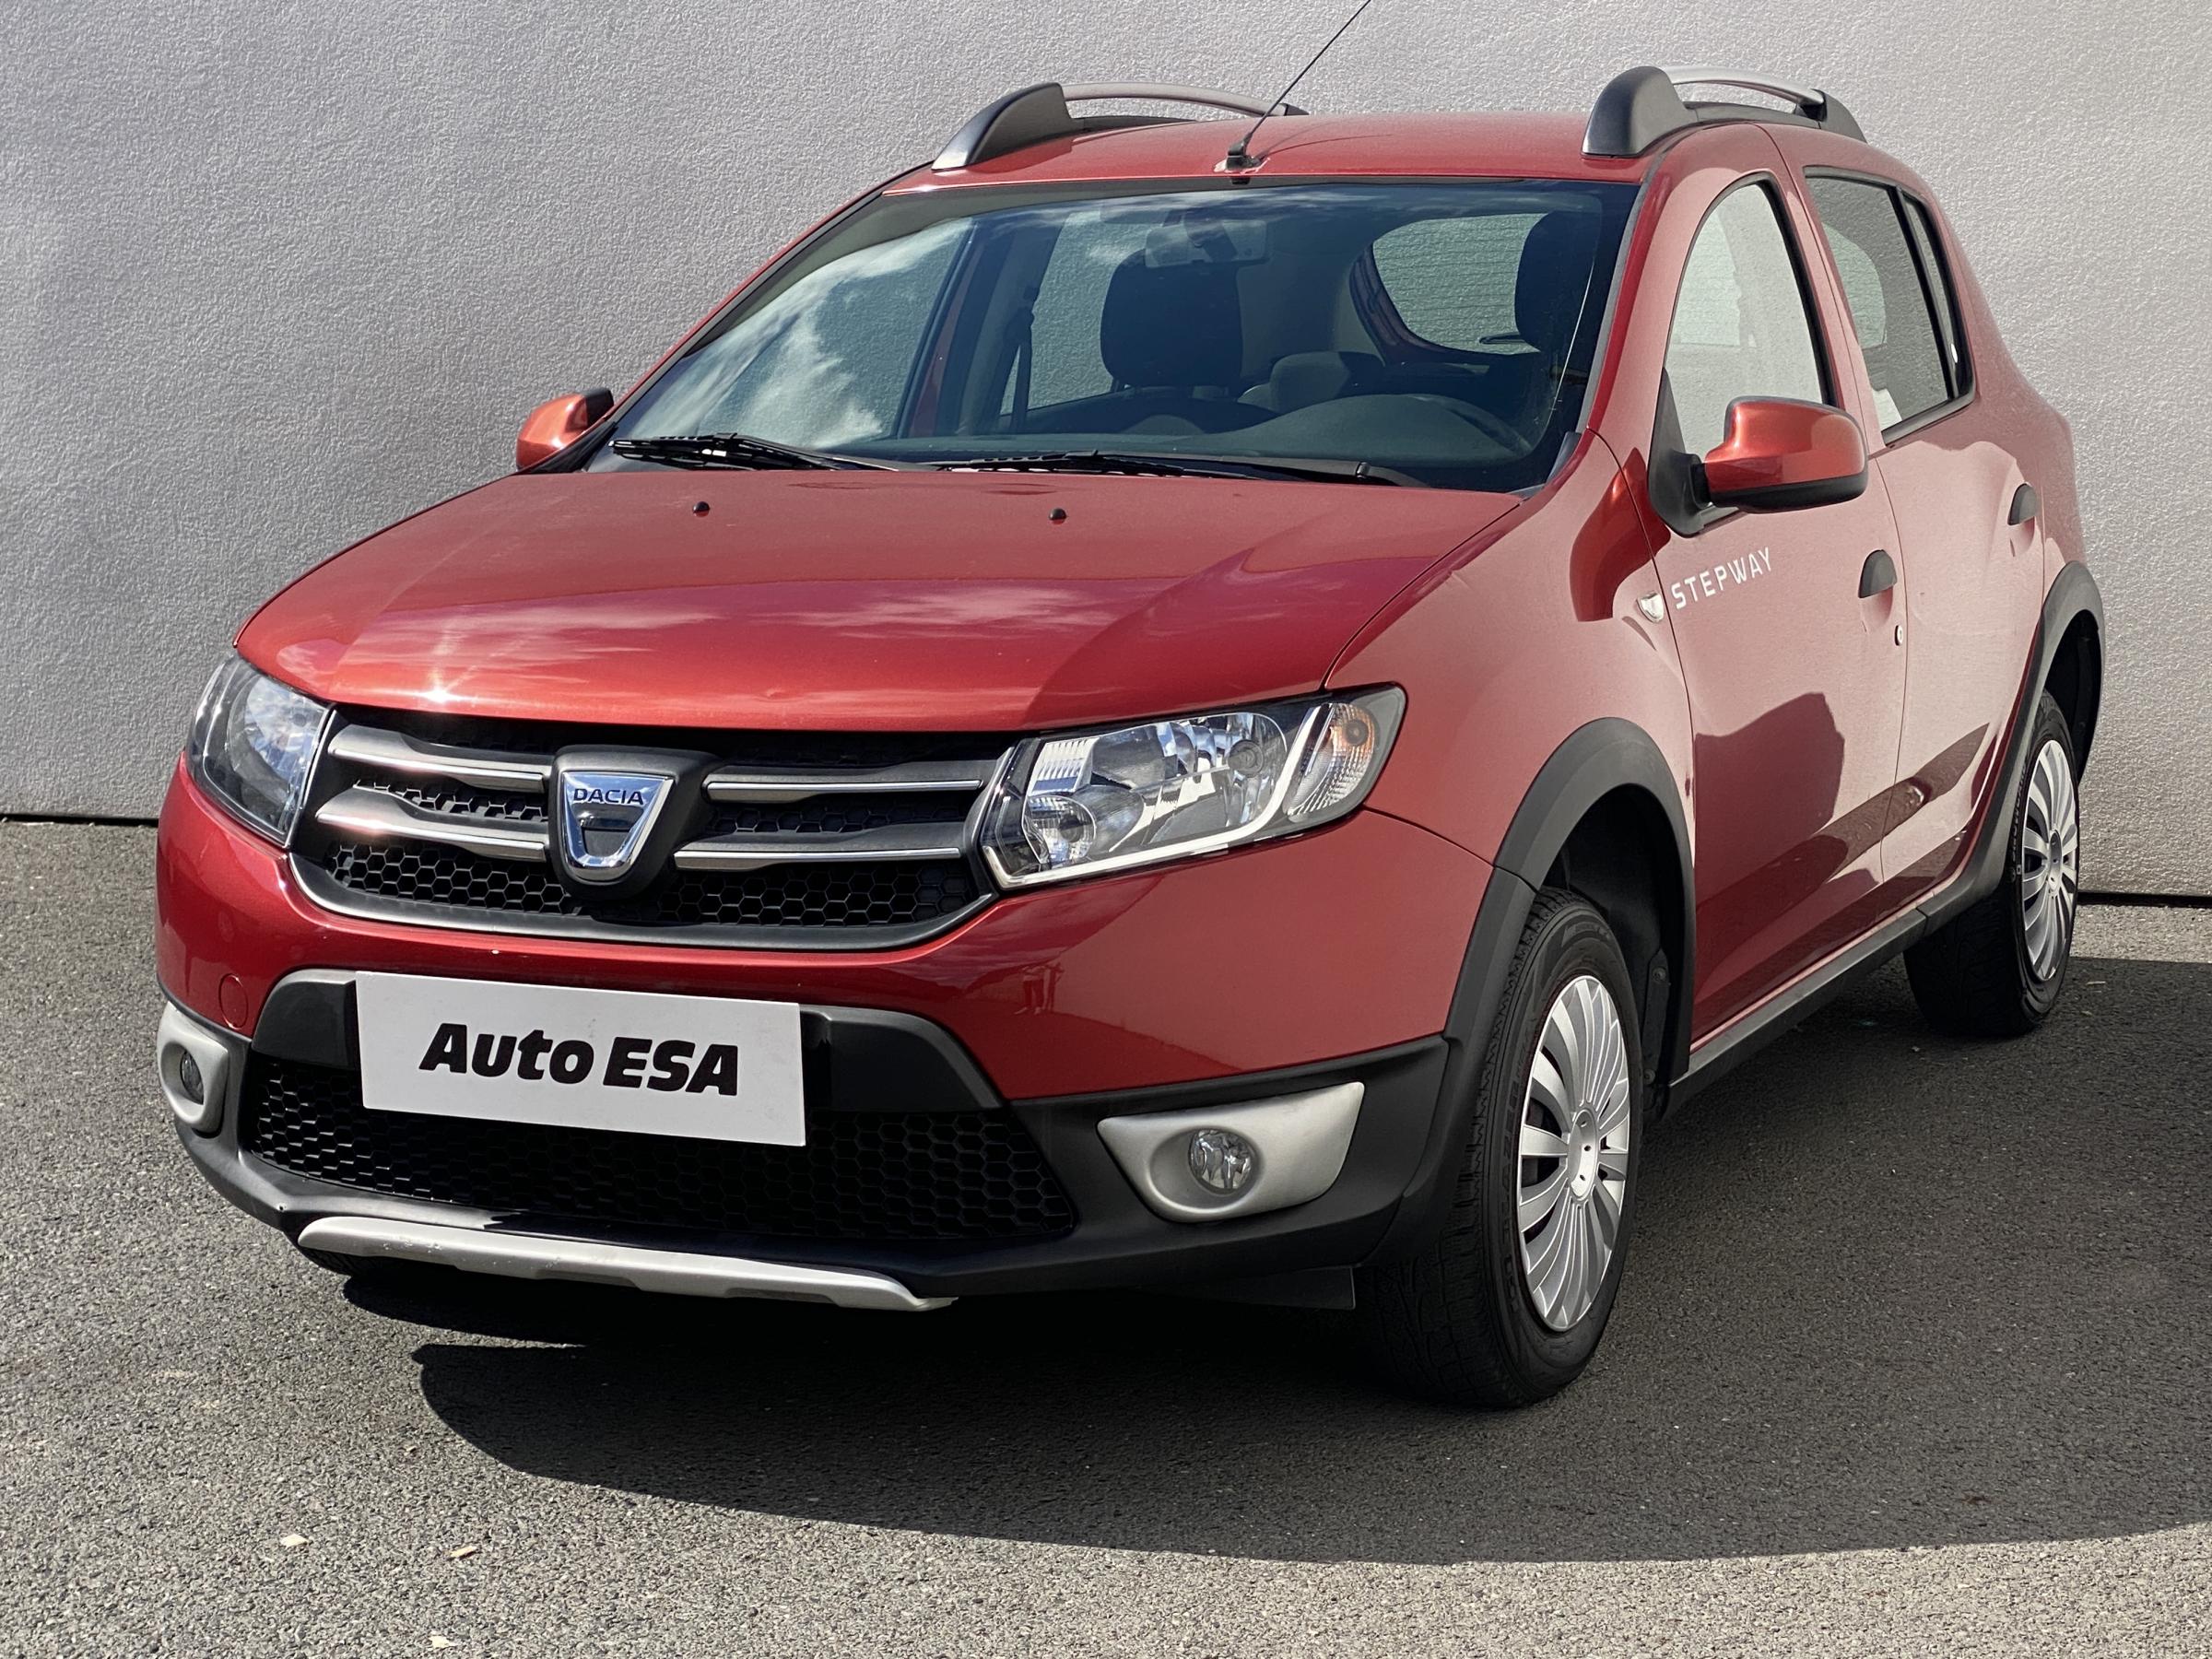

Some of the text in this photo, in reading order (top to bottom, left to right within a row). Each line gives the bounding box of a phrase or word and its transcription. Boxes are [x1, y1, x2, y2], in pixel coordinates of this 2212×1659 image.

[1671, 547, 1771, 609] STEPWAY
[573, 788, 644, 806] DACIA
[418, 1023, 738, 1097] Auto ESA
